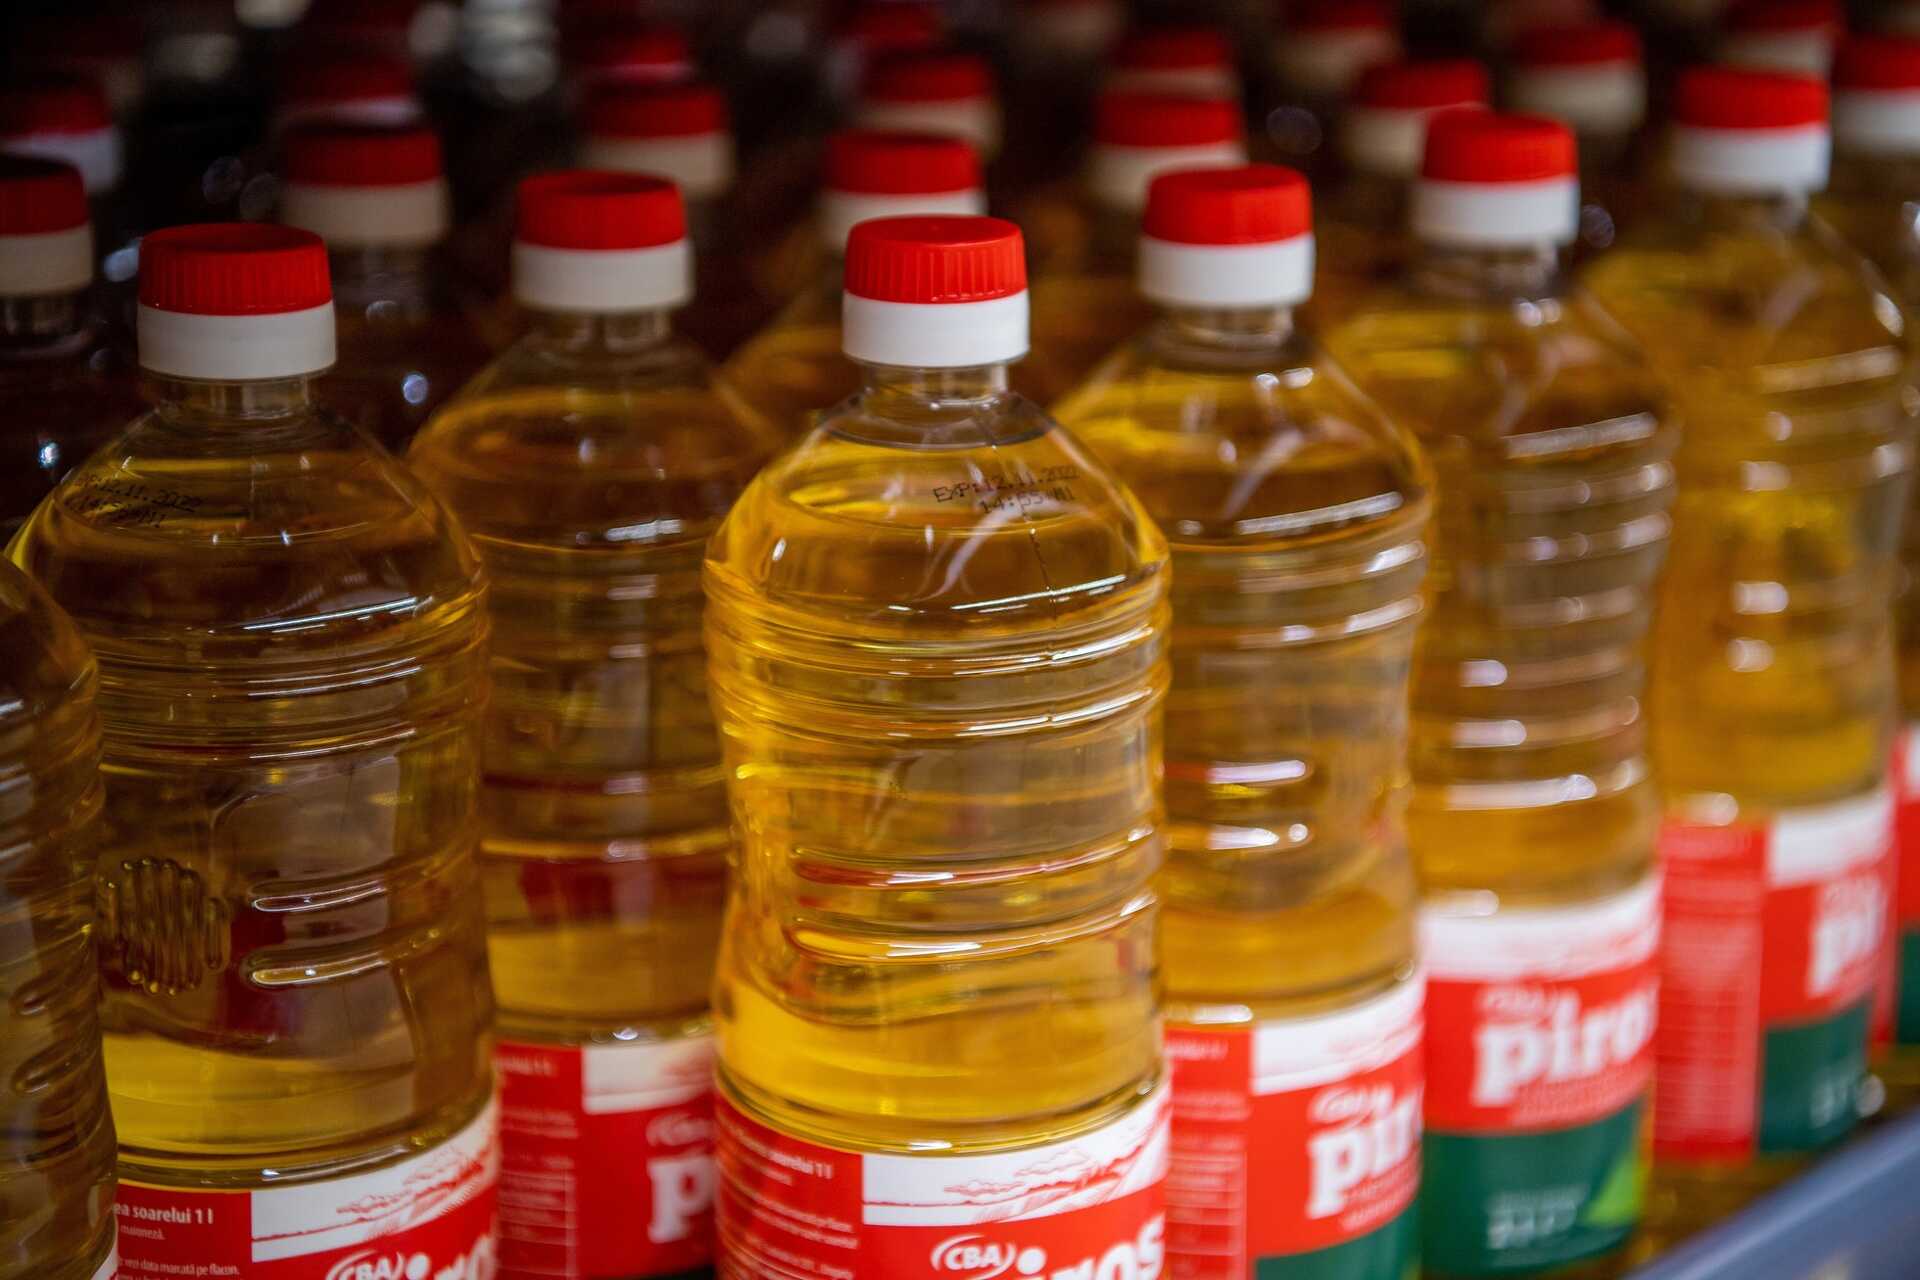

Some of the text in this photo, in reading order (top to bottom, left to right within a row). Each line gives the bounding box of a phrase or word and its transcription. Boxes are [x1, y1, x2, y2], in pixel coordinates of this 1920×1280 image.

[132, 1204, 191, 1224] soarelui
[194, 1208, 204, 1225] 1
[944, 1243, 1003, 1272] CBA
[196, 1265, 208, 1279] pe
